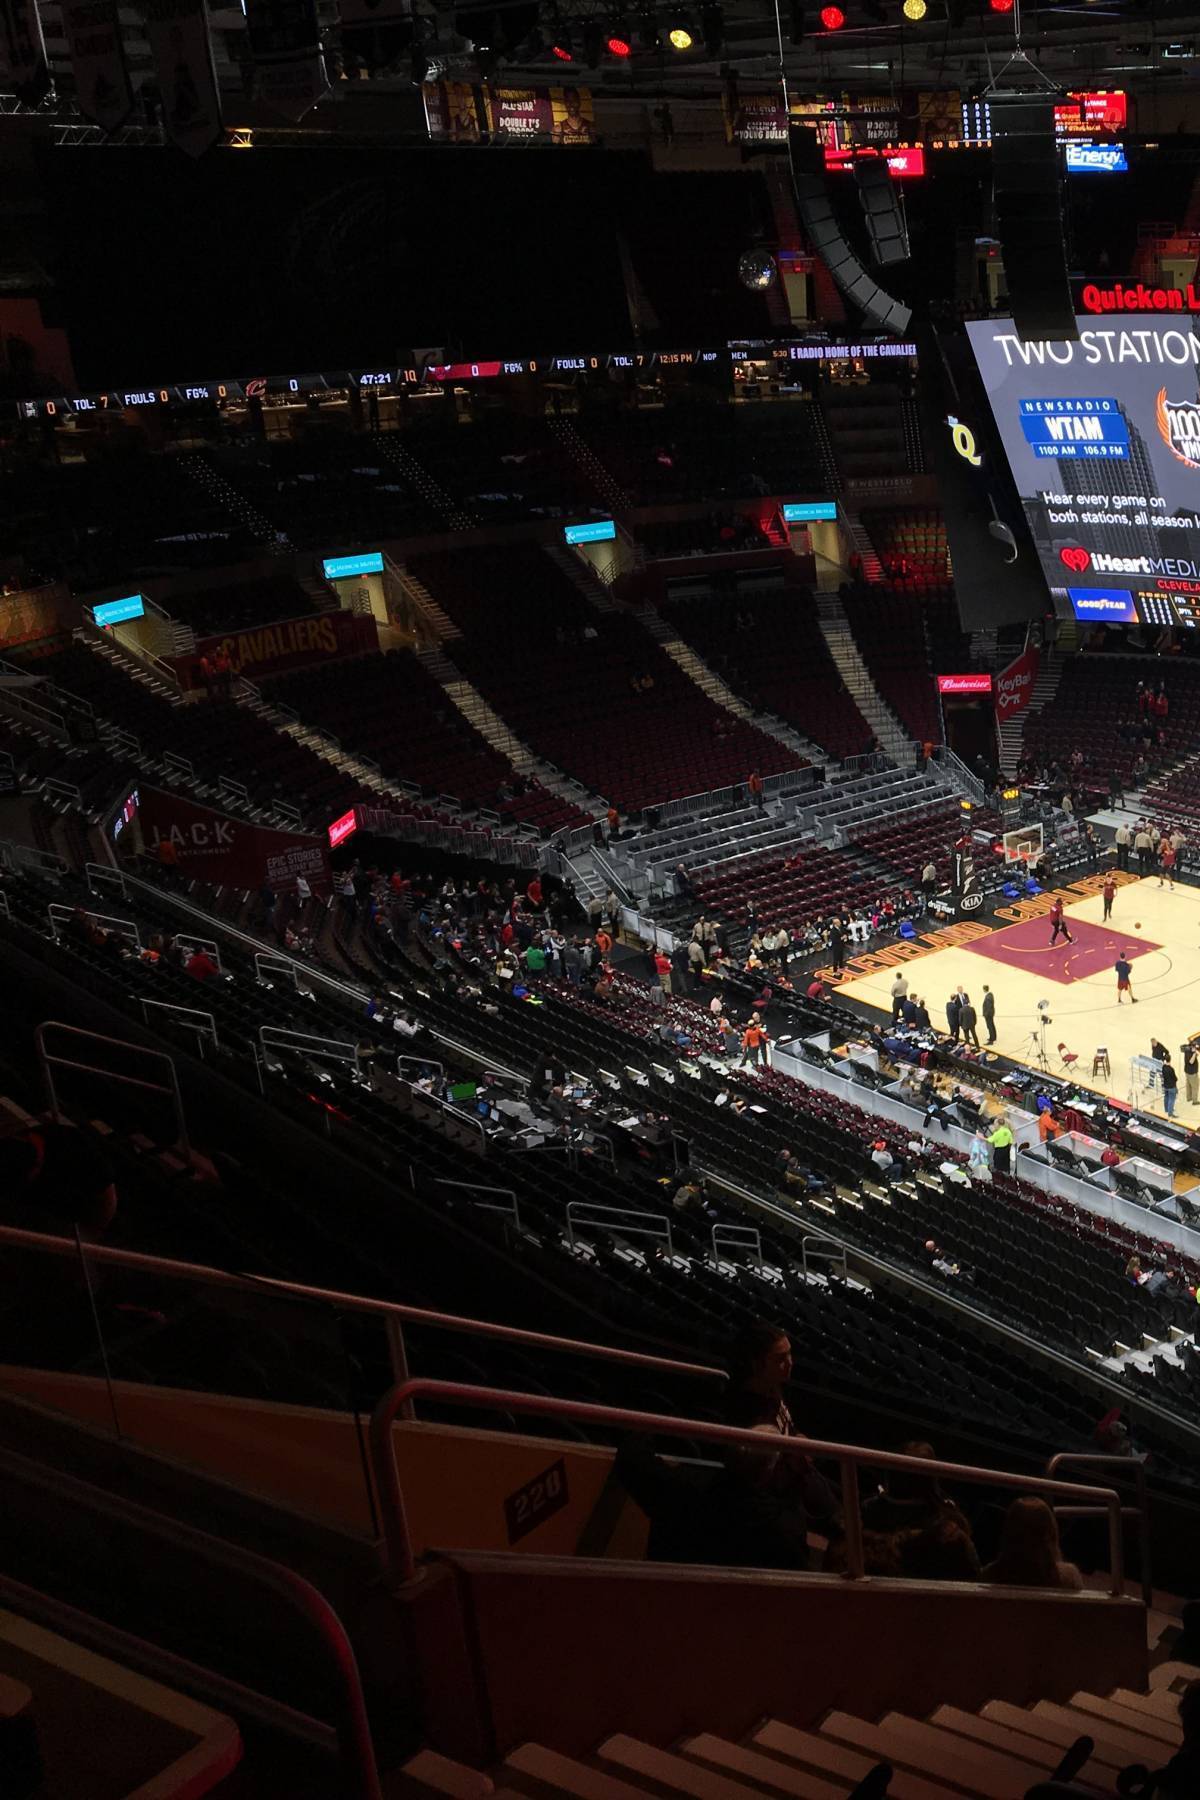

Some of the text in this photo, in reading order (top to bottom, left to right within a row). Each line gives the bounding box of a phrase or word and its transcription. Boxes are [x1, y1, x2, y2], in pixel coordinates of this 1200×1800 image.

[499, 117, 527, 129] DOUBLE
[1083, 285, 1184, 313] Quicken
[798, 345, 878, 358] RADIO HOME OF THE
[993, 335, 1073, 366] TWO
[557, 357, 598, 369] FOULS 0
[613, 356, 644, 367] TOL: 7
[659, 353, 693, 364] 12:15 PM
[471, 364, 479, 377] 0
[504, 361, 536, 374] FG% 0
[360, 373, 392, 385] 47:21
[403, 370, 417, 382] 1Q
[186, 385, 226, 399] FG% 0
[289, 379, 299, 392] 0
[73, 395, 108, 411] TOL: 7
[125, 391, 169, 405] FOULS 0
[46, 401, 56, 415] 0
[1025, 401, 1110, 412] NEWSRADIO
[1044, 416, 1104, 441] WTAM
[952, 424, 981, 466] Q
[1039, 445, 1124, 456] 1100 AM 106.9 FM
[1042, 491, 1167, 510] Hear every game on
[1048, 509, 1079, 524] both
[1081, 510, 1132, 527] stations,
[1134, 513, 1149, 527] all
[1151, 516, 1193, 529] season
[1077, 599, 1127, 611] GOODYEAR
[222, 617, 337, 673] CAVALIERS
[941, 679, 990, 689] Budweiser
[267, 849, 322, 869] EPIC STORIES
[928, 900, 942, 912] drug
[963, 896, 980, 908] KIA
[815, 920, 992, 986] CLEVELAND
[514, 1470, 561, 1523] 220
